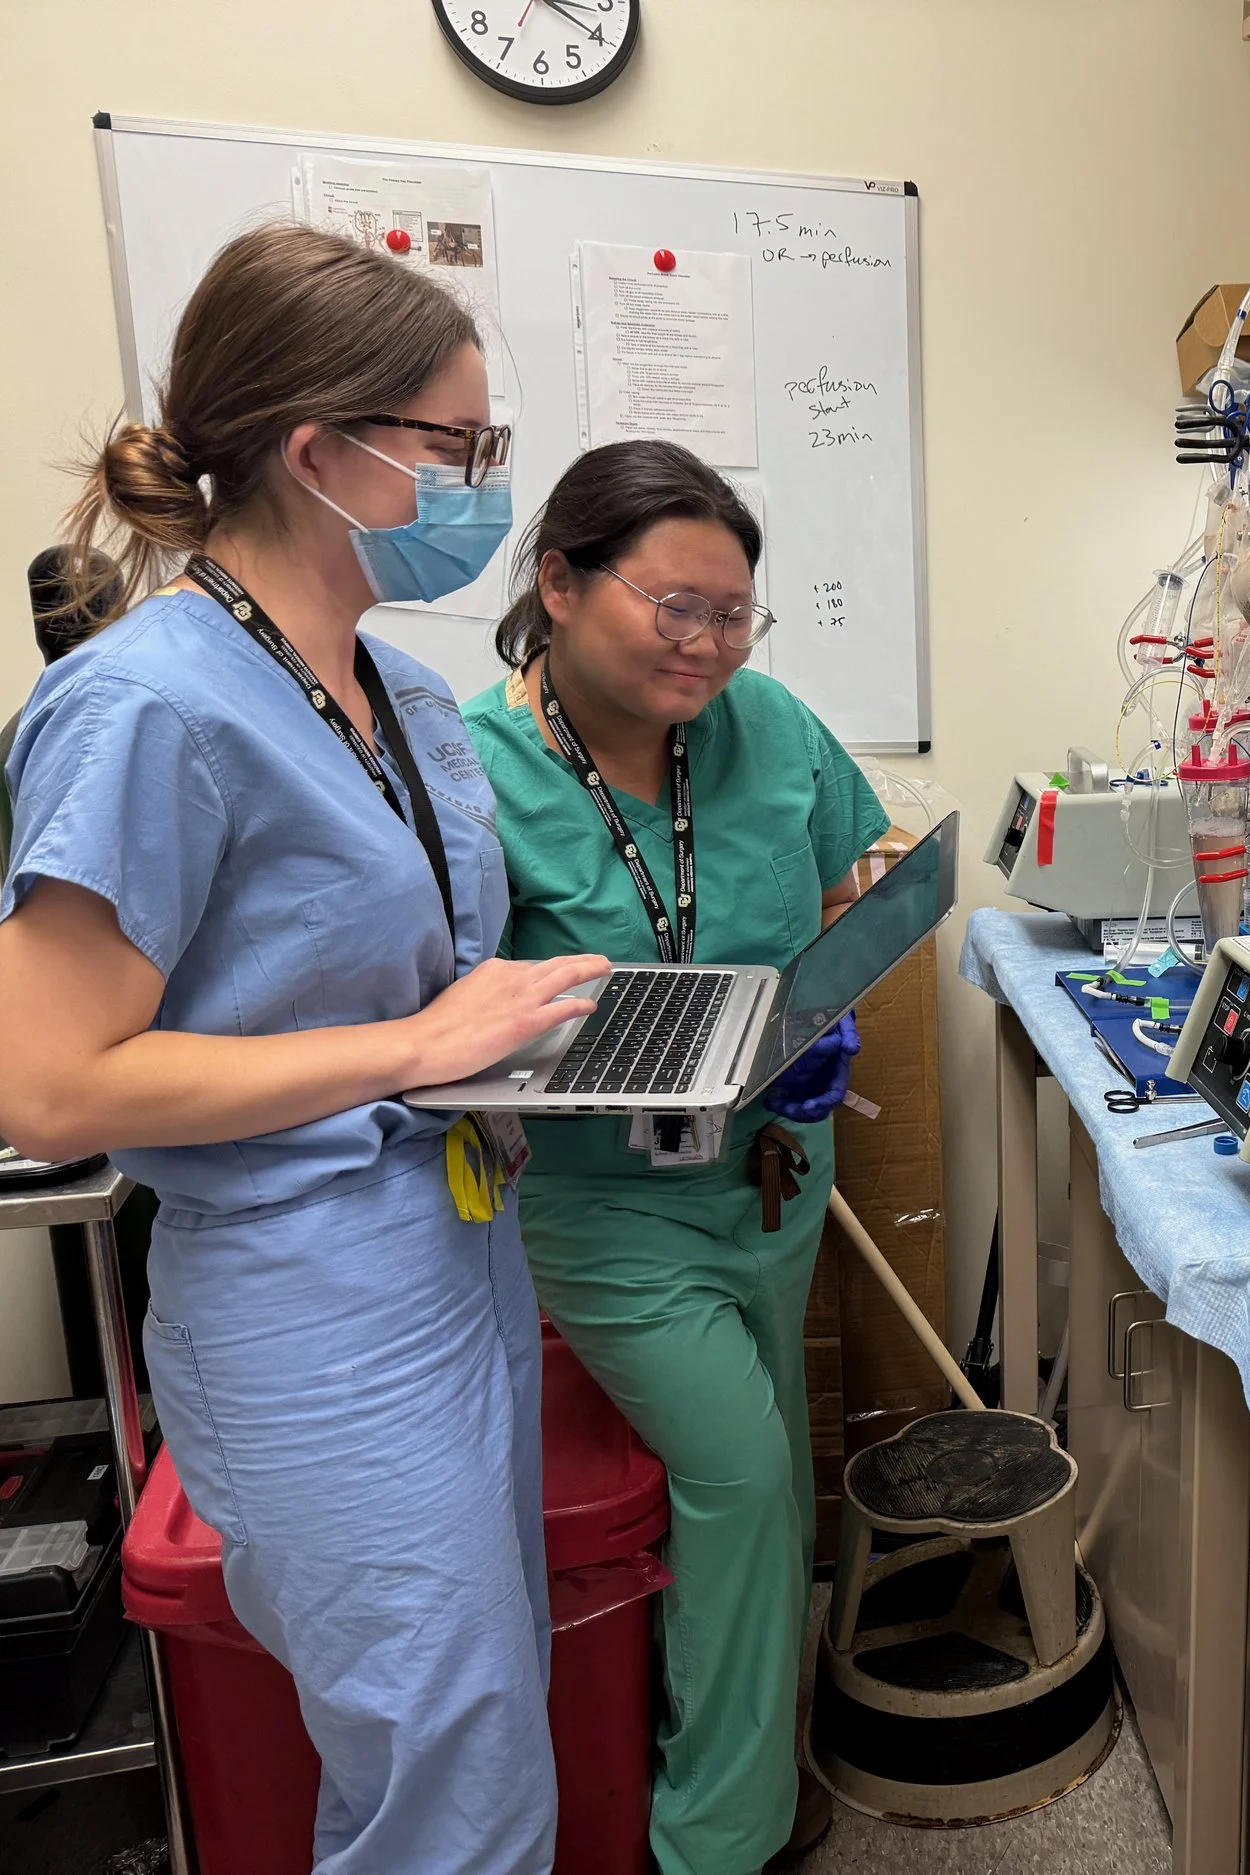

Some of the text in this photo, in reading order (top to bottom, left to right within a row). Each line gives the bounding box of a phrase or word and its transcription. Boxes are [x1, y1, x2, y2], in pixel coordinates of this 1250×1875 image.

[471, 10, 489, 35] 8
[587, 22, 604, 47] 4
[497, 36, 515, 61] 7
[565, 44, 582, 69] 5
[533, 50, 550, 75] 6
[876, 185, 899, 193] VIZ-PRO
[733, 212, 837, 238] 17.5 min
[762, 246, 892, 269] OR perfusion
[784, 364, 878, 401] perfusion
[203, 572, 234, 605] Department
[823, 580, 843, 593] 200
[275, 648, 284, 657] of
[281, 654, 312, 690] Department
[326, 716, 348, 741] Surgery
[555, 713, 588, 766] Department of Surgery
[595, 785, 614, 813] Department
[632, 857, 650, 886] Department
[646, 890, 661, 910] Surgery
[678, 864, 687, 892] Department
[1221, 1002, 1231, 1012] STOP
